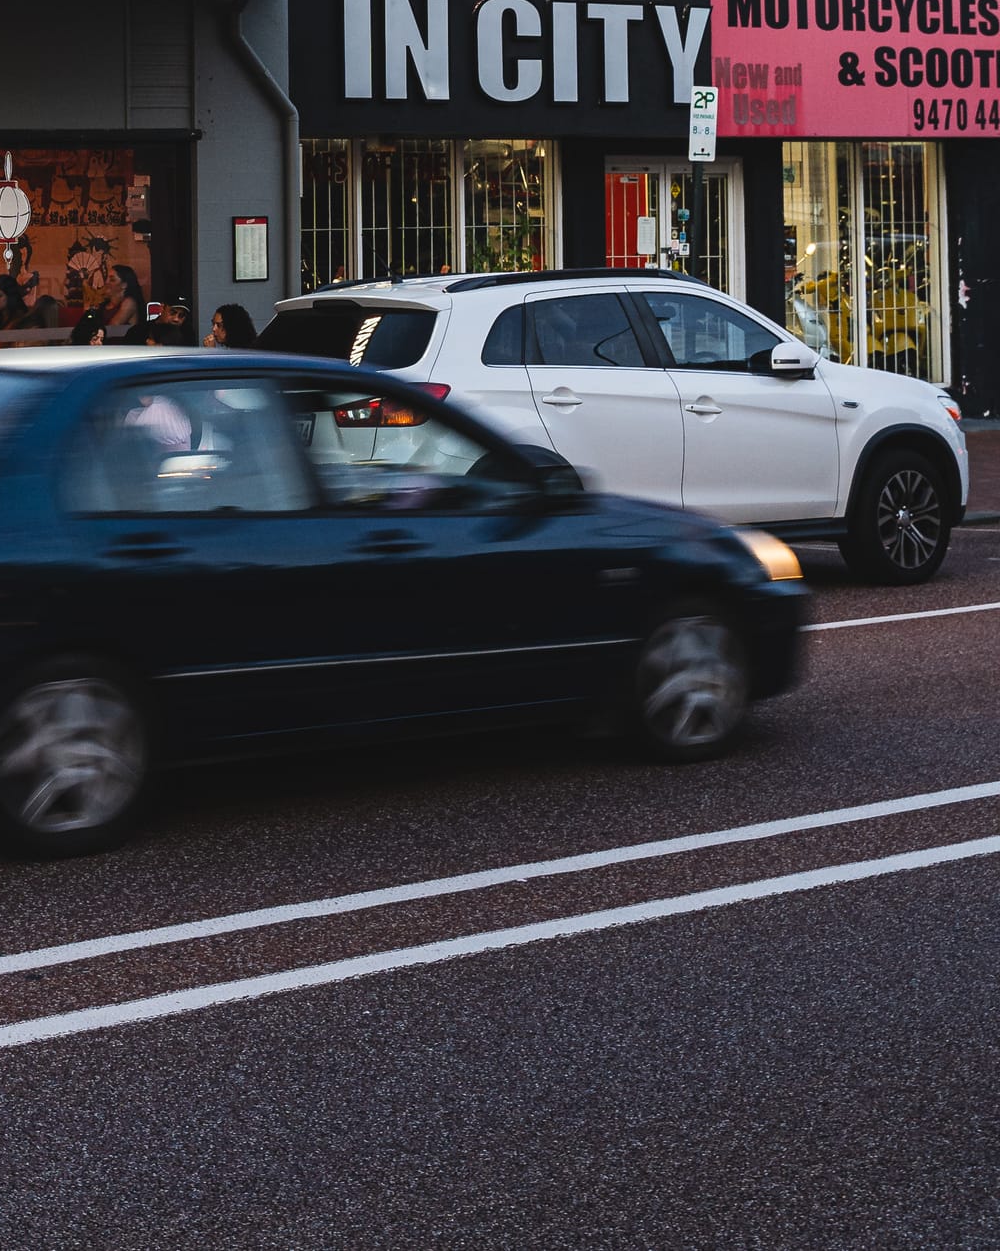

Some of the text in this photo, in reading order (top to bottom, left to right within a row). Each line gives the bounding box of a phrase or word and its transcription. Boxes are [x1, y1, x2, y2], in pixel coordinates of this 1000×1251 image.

[714, 56, 803, 90] New and
[837, 45, 1000, 89] & SCOOT
[694, 91, 715, 109] 2P
[732, 93, 797, 127] Used
[913, 98, 1000, 132] 9470 44
